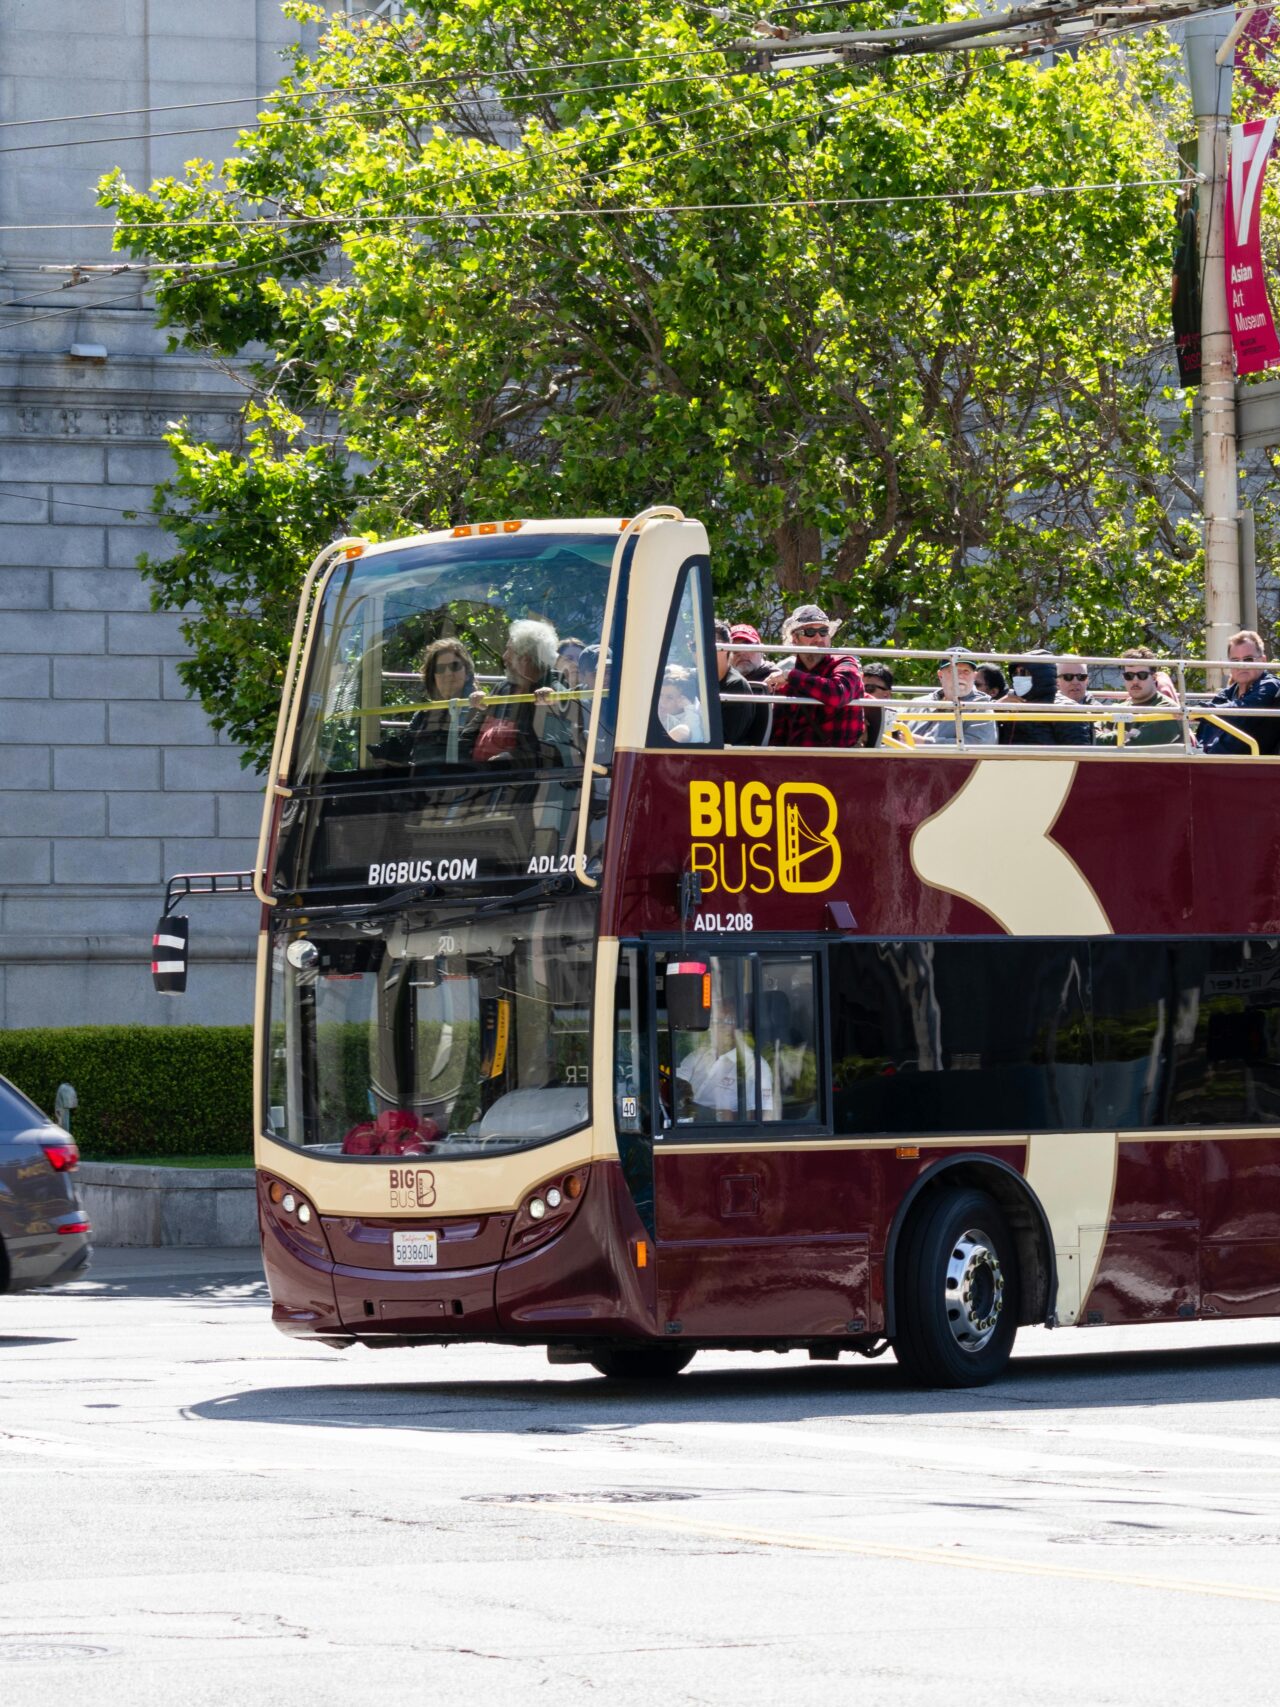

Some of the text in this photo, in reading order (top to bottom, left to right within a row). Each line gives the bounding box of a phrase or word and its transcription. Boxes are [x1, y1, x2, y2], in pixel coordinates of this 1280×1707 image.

[1231, 263, 1253, 284] Asian
[1233, 289, 1245, 308] Art
[1234, 312, 1267, 332] Museum
[689, 780, 773, 838] BIG
[368, 858, 478, 885] BIGBUS.COM
[691, 842, 775, 894] BUS
[693, 913, 754, 931] ADL208
[438, 935, 455, 953] 20
[623, 1102, 635, 1116] 40
[389, 1169, 415, 1189] BIG
[390, 1190, 416, 1208] BUS
